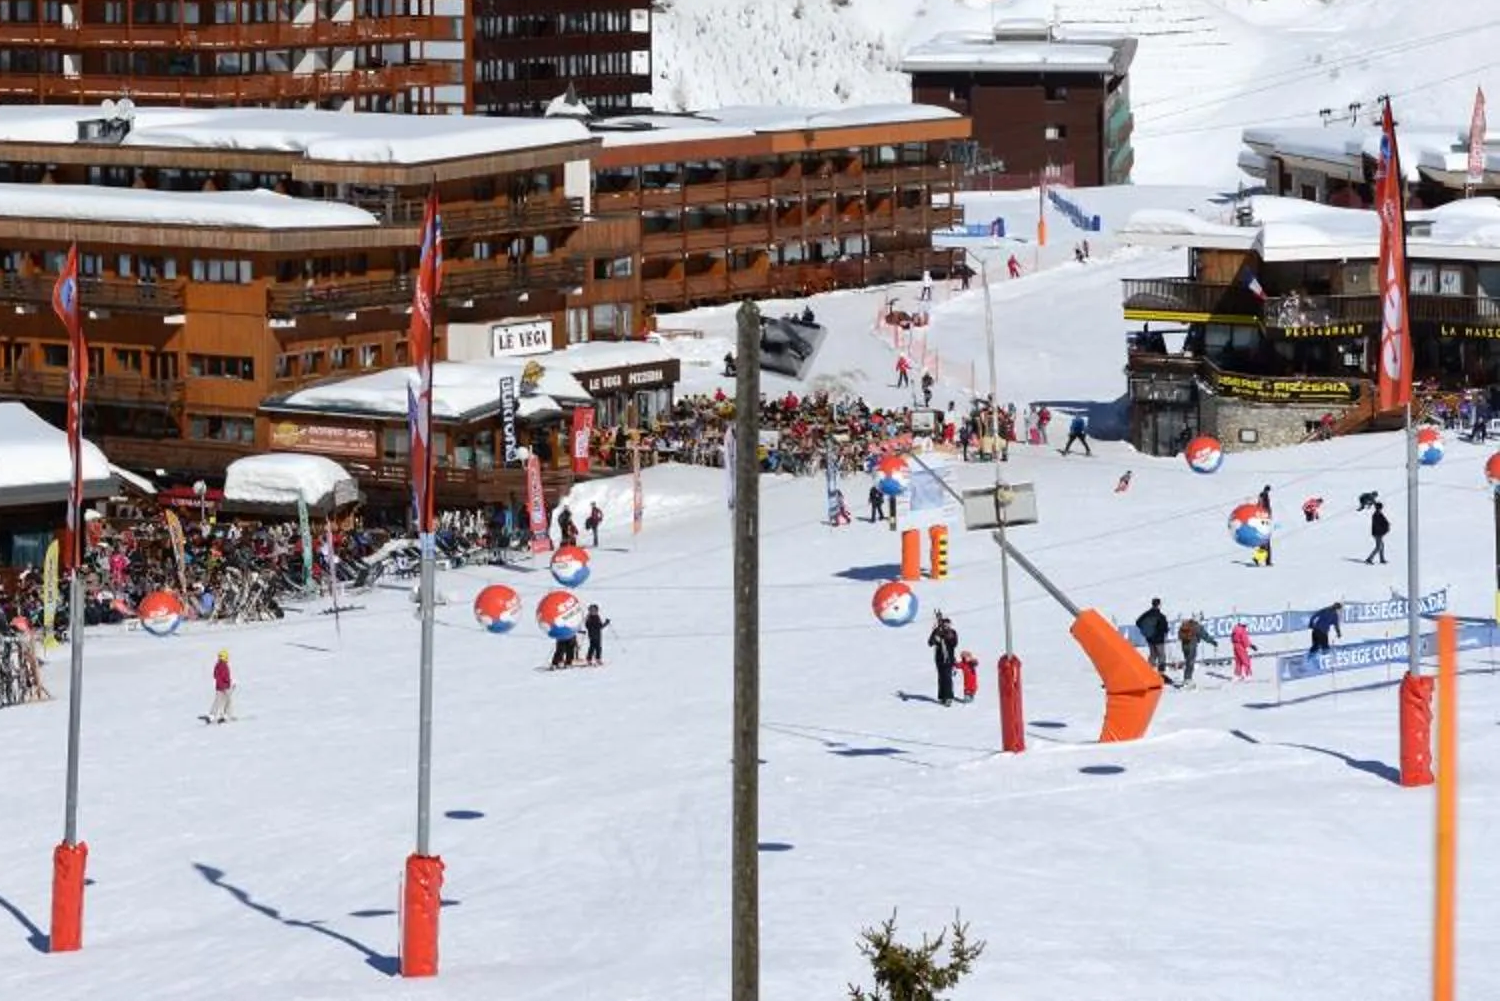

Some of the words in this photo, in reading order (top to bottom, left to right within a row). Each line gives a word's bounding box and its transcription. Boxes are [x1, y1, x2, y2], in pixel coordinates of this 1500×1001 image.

[499, 333, 514, 350] LE
[519, 328, 547, 348] VEGA
[1217, 614, 1284, 636] CORADO
